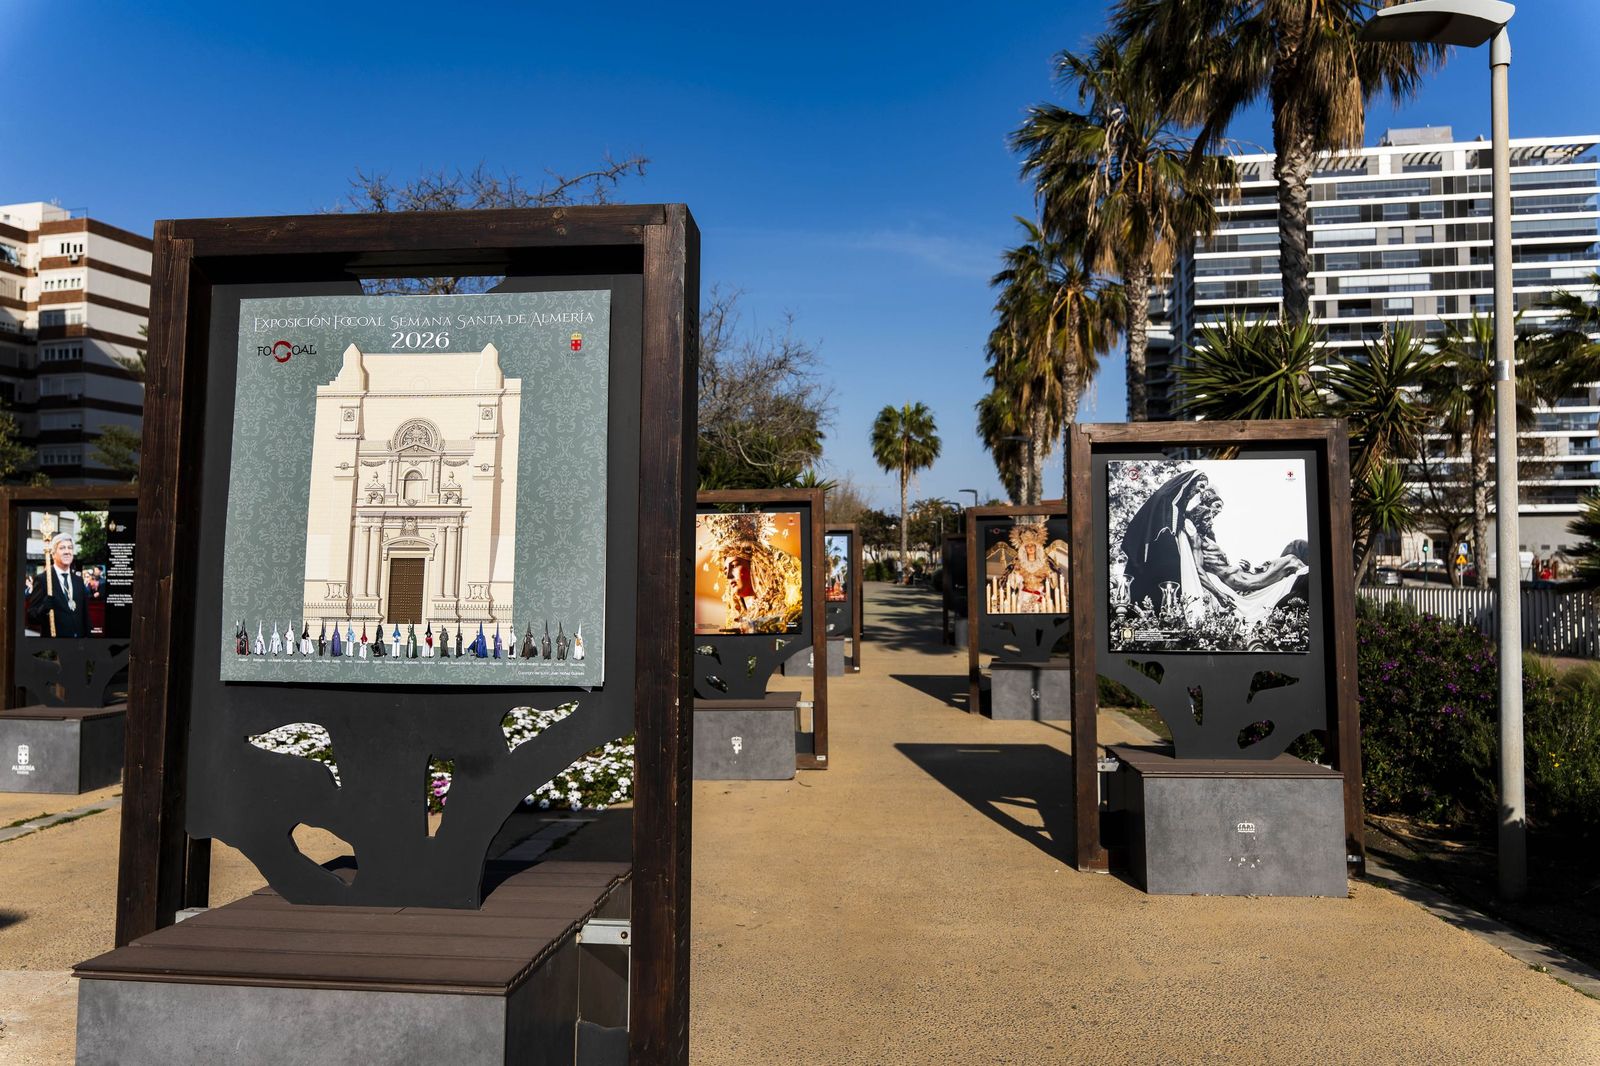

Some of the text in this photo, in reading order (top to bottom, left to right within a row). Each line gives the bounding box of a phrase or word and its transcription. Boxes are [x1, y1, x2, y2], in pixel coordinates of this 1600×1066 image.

[388, 314, 452, 330] SEMANA
[456, 314, 504, 330] SANTA
[507, 313, 526, 325] DE
[391, 331, 450, 349] 2026
